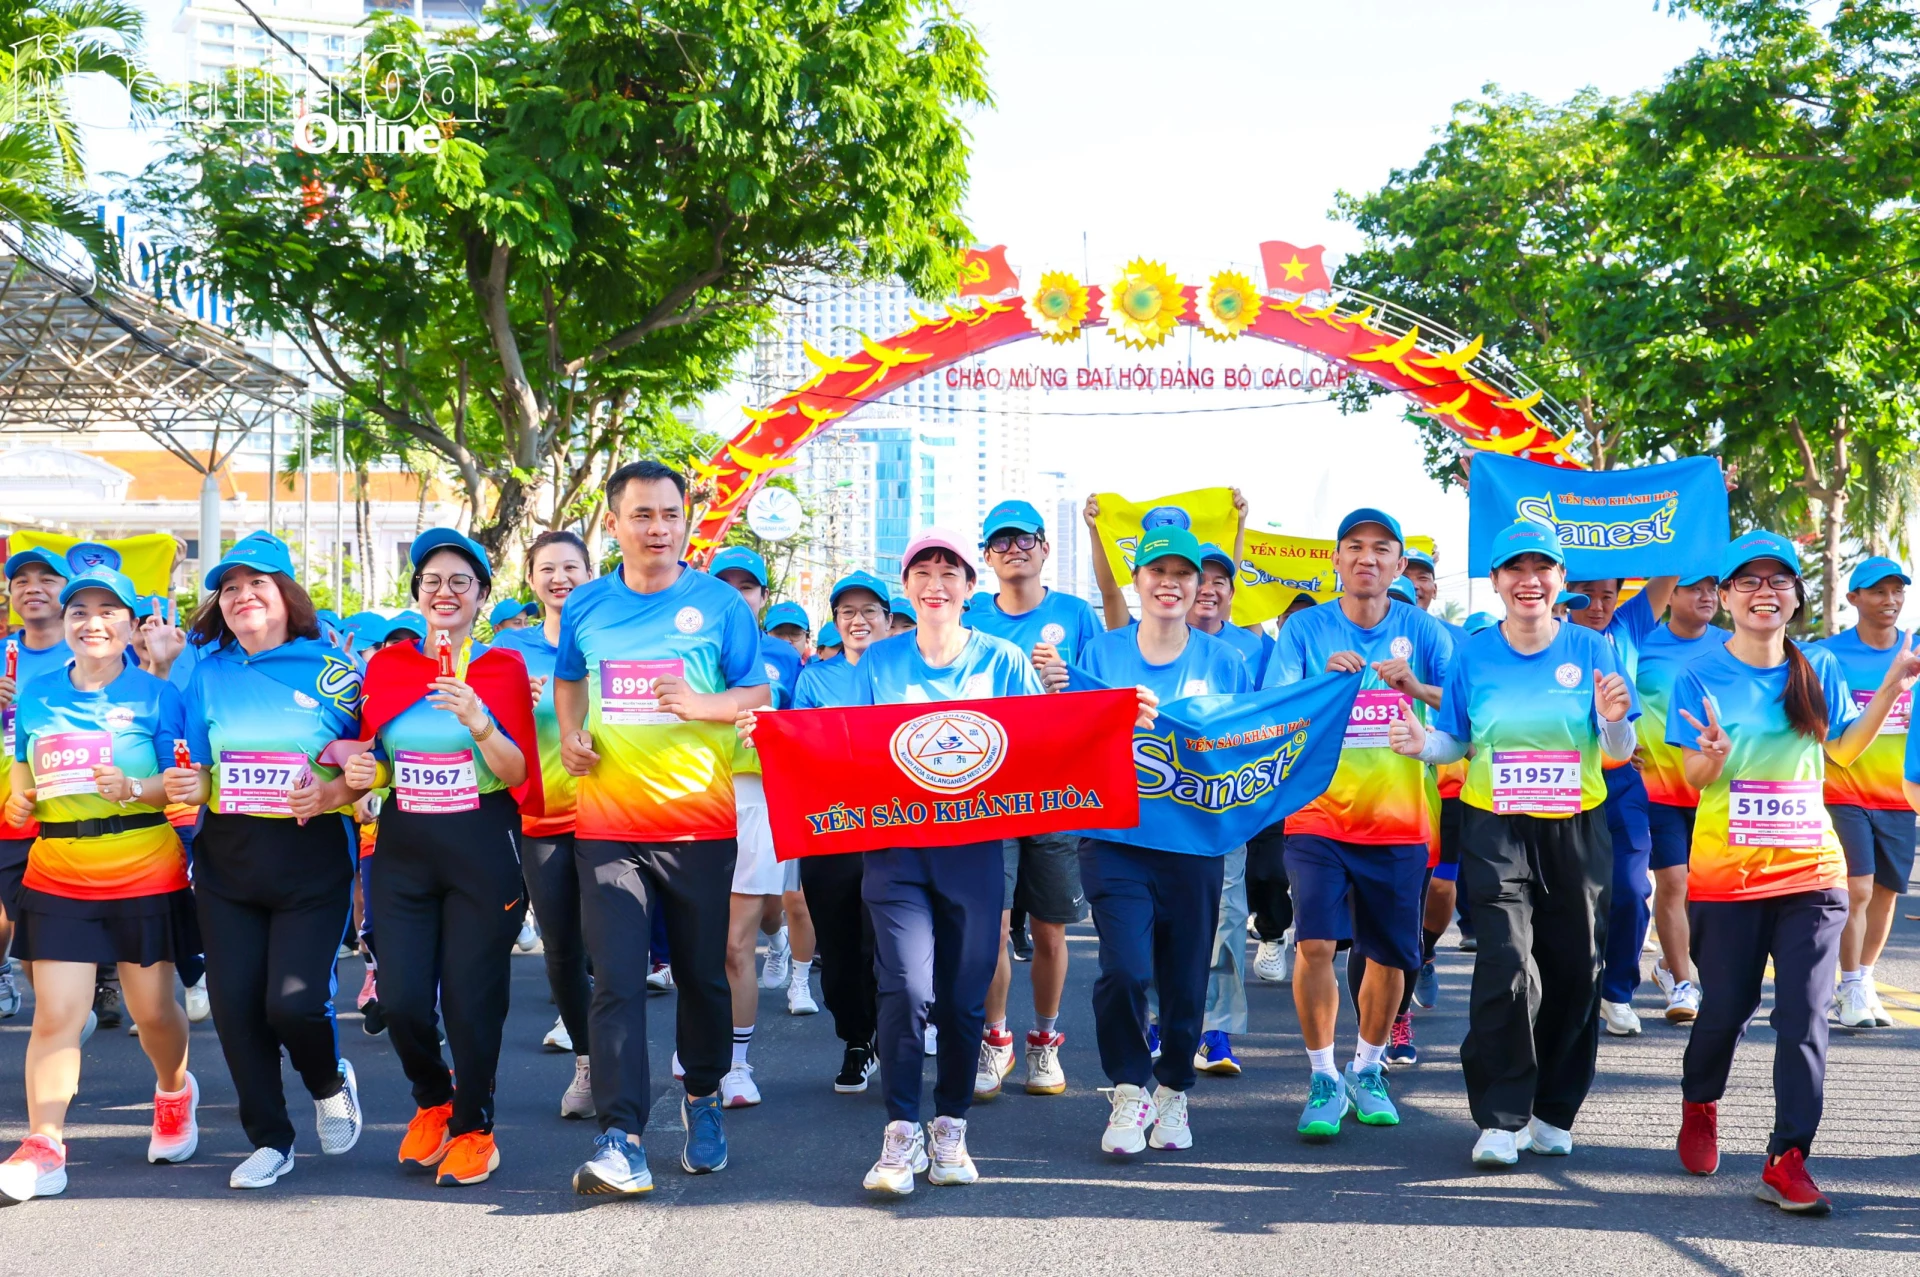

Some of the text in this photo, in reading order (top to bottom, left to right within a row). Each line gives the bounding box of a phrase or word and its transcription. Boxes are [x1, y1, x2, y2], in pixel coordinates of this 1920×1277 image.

[945, 363, 1001, 388] CHÀO
[1009, 363, 1067, 388] MỪNG
[1076, 367, 1112, 391] ĐẠI
[1119, 363, 1153, 391] HỘI
[1160, 360, 1214, 388] ĐẢNG
[1224, 363, 1251, 391] BỘ
[1262, 363, 1301, 388] CÁC
[1558, 491, 1582, 504] YẾN
[1608, 492, 1651, 506] KHÁNH
[1519, 499, 1672, 548] Sanest
[1250, 542, 1277, 557] YẾN
[1240, 560, 1322, 593] Sanest
[1349, 704, 1399, 721] 0633
[1184, 734, 1215, 752] YẾN
[1216, 731, 1241, 750] SÀO
[1244, 725, 1284, 745] KHÁNH
[41, 747, 89, 770] 0999
[925, 774, 967, 785] SALANGANES
[967, 768, 981, 779] NEST
[981, 745, 999, 770] COMPAN
[228, 767, 291, 785] 51977
[401, 767, 460, 785] 51967
[1132, 735, 1294, 810] Sanest
[1500, 767, 1565, 784] 51957
[806, 784, 1104, 835] YẾN SÀO KHÁNH HÒA
[1737, 798, 1807, 816] 51965
